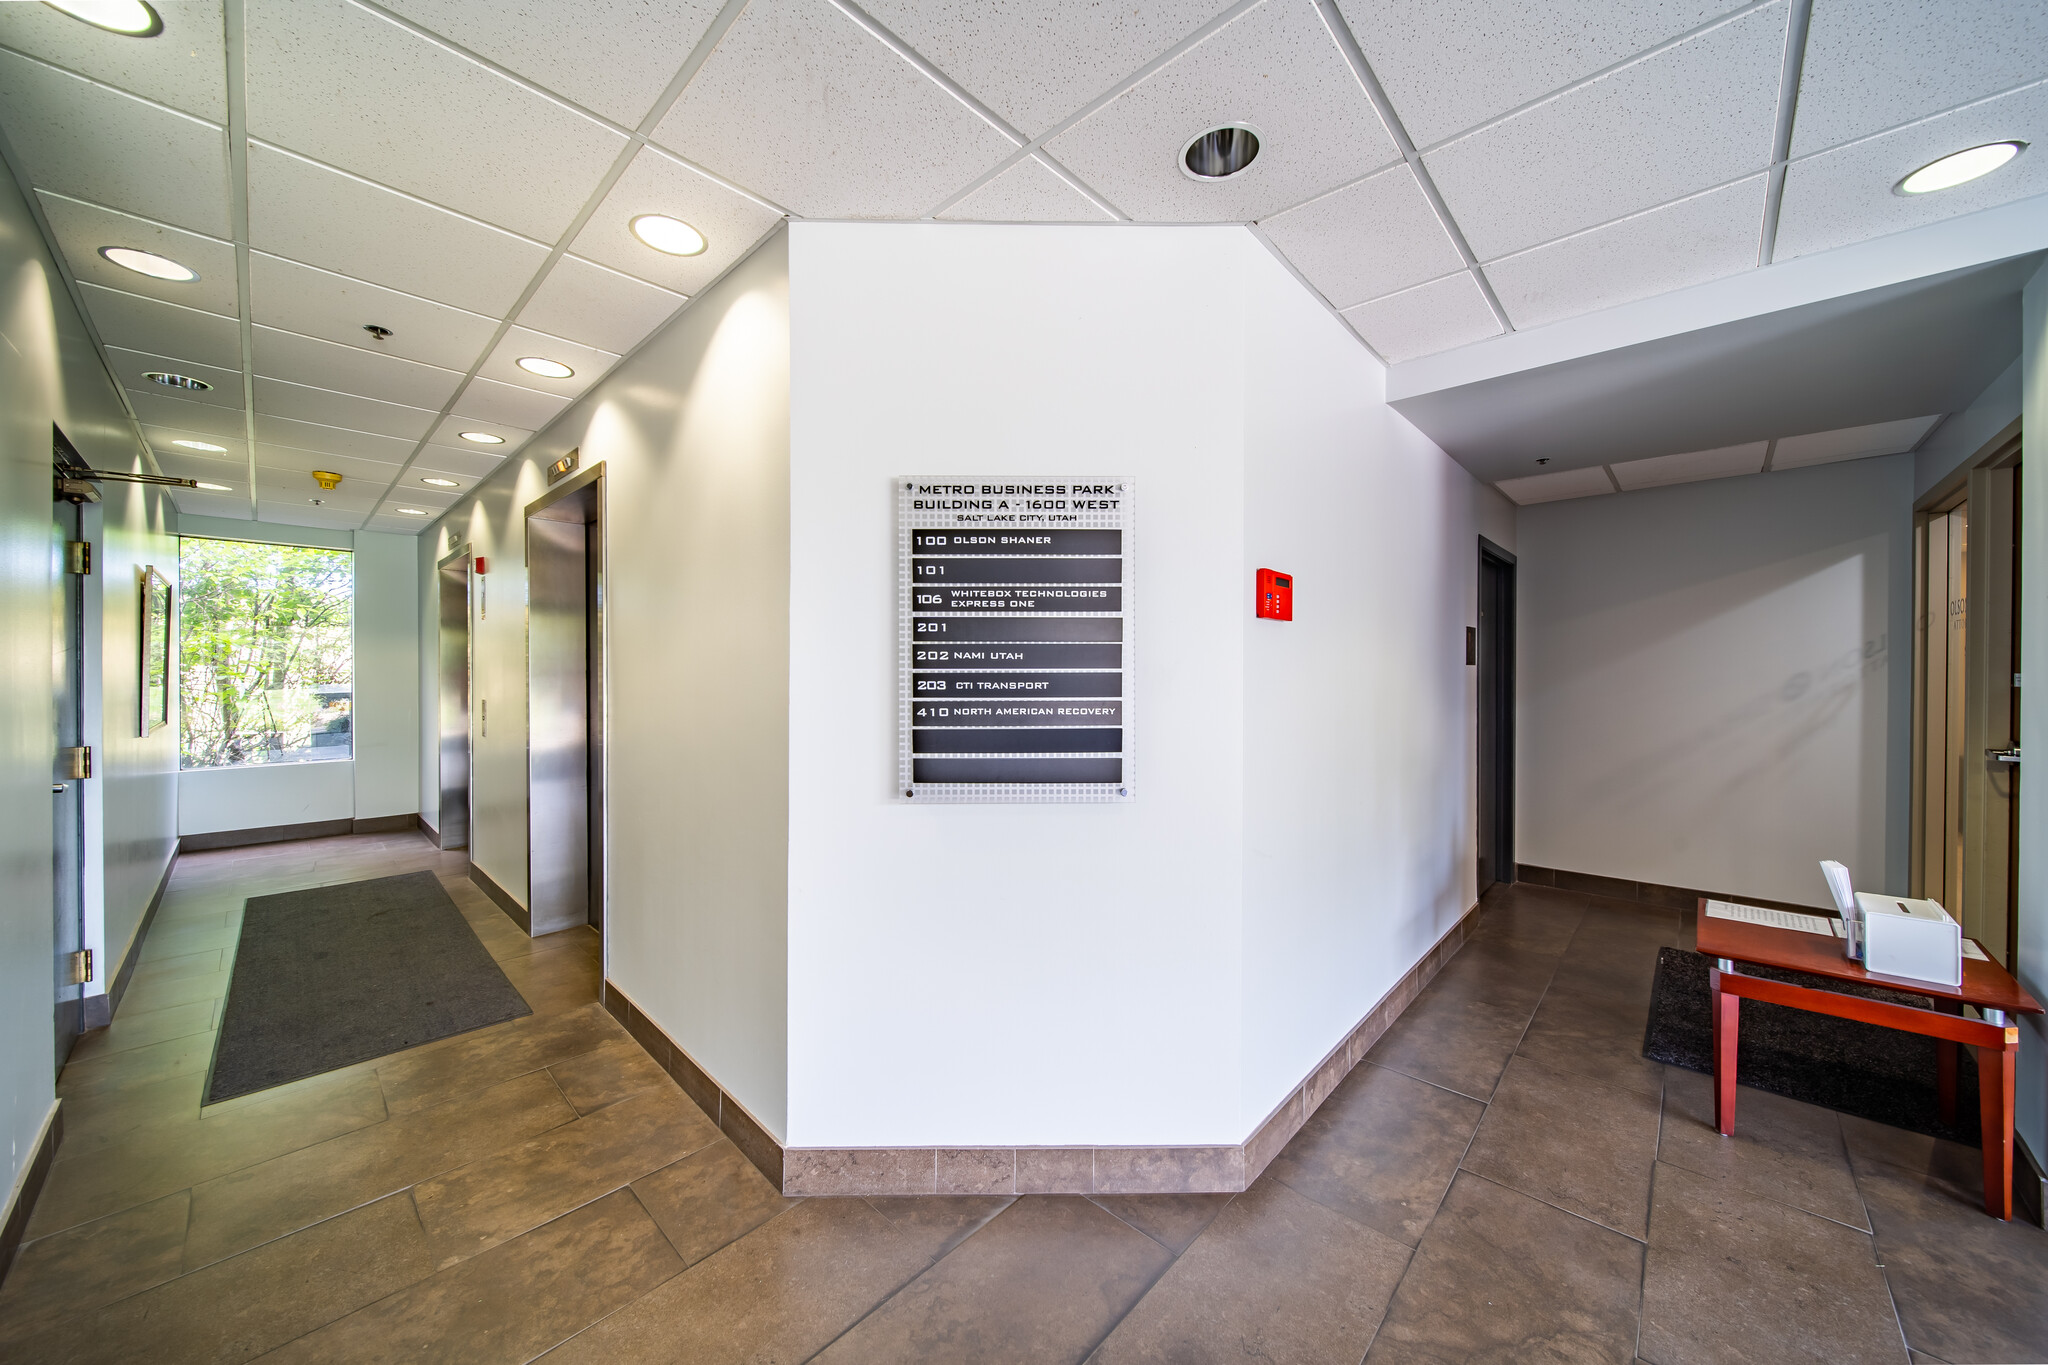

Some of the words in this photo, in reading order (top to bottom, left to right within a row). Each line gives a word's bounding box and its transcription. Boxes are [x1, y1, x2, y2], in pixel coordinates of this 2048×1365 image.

[919, 485, 975, 494] METRO
[982, 485, 1066, 494] BUSINESS
[1073, 485, 1115, 494] PARK
[914, 500, 992, 509] BUILDING
[999, 500, 1009, 509] A
[1026, 500, 1066, 509] 1600
[1073, 500, 1120, 509] WEST
[917, 537, 947, 545] 100
[917, 566, 944, 575] 101
[917, 595, 942, 604] 106
[917, 623, 947, 632] 201
[917, 651, 949, 660] 202
[917, 681, 946, 690] 203
[917, 708, 949, 717] 410
